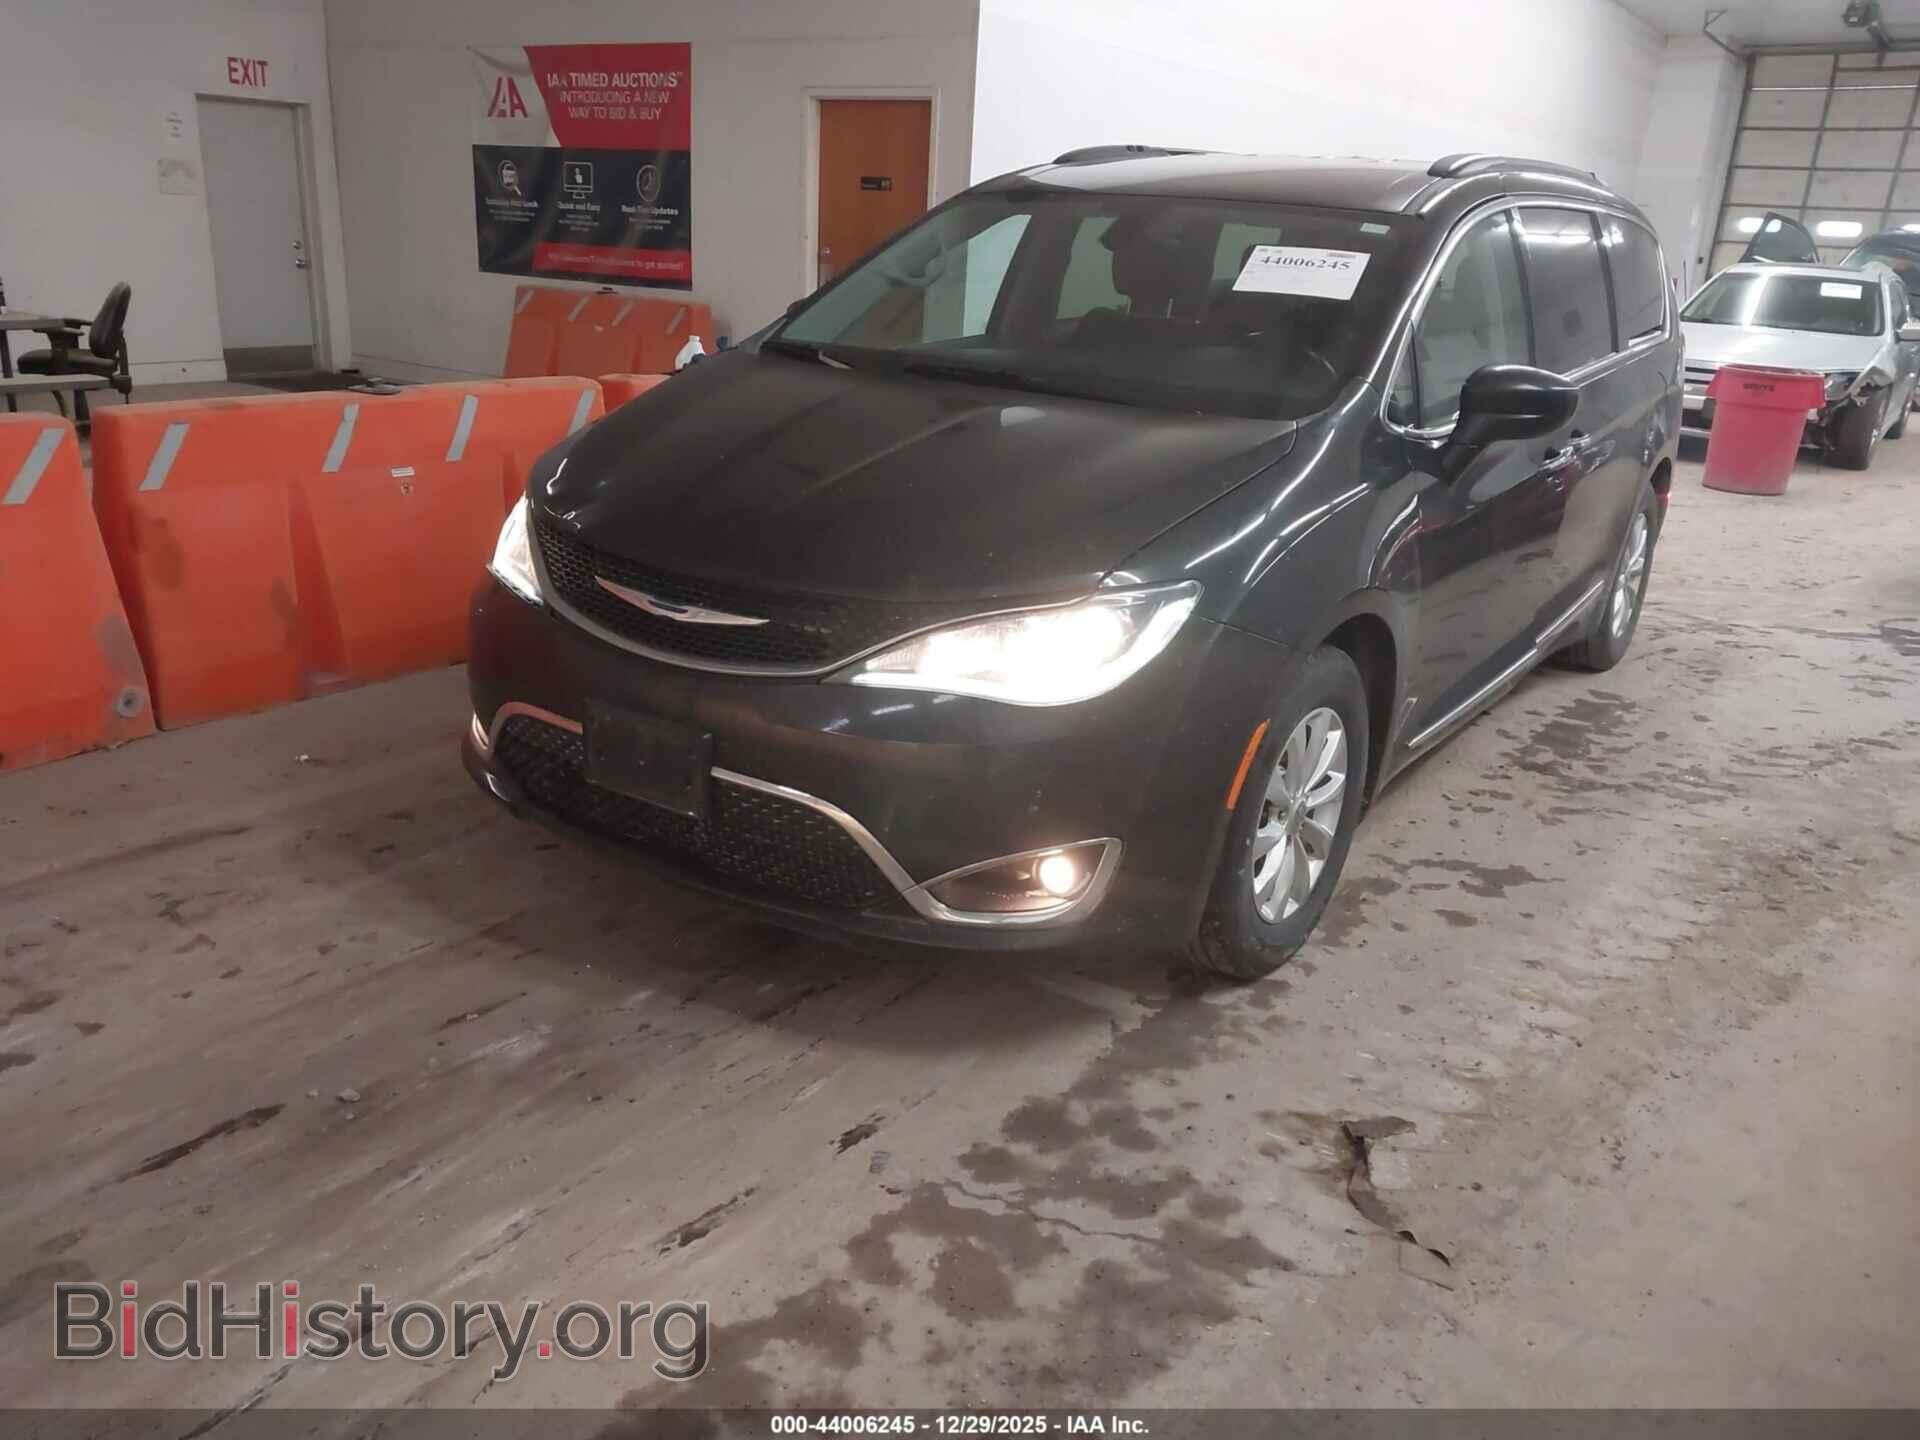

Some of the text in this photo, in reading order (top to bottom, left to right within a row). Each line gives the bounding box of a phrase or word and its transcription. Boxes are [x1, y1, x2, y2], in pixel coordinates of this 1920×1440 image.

[227, 56, 268, 88] EXIT
[569, 73, 609, 88] TIMED
[560, 91, 632, 104] INTRODUCING
[568, 106, 591, 120] WAY
[592, 106, 607, 120] TO
[608, 106, 626, 120] BID
[640, 107, 662, 121] BUY
[1261, 255, 1352, 271] 44006245
